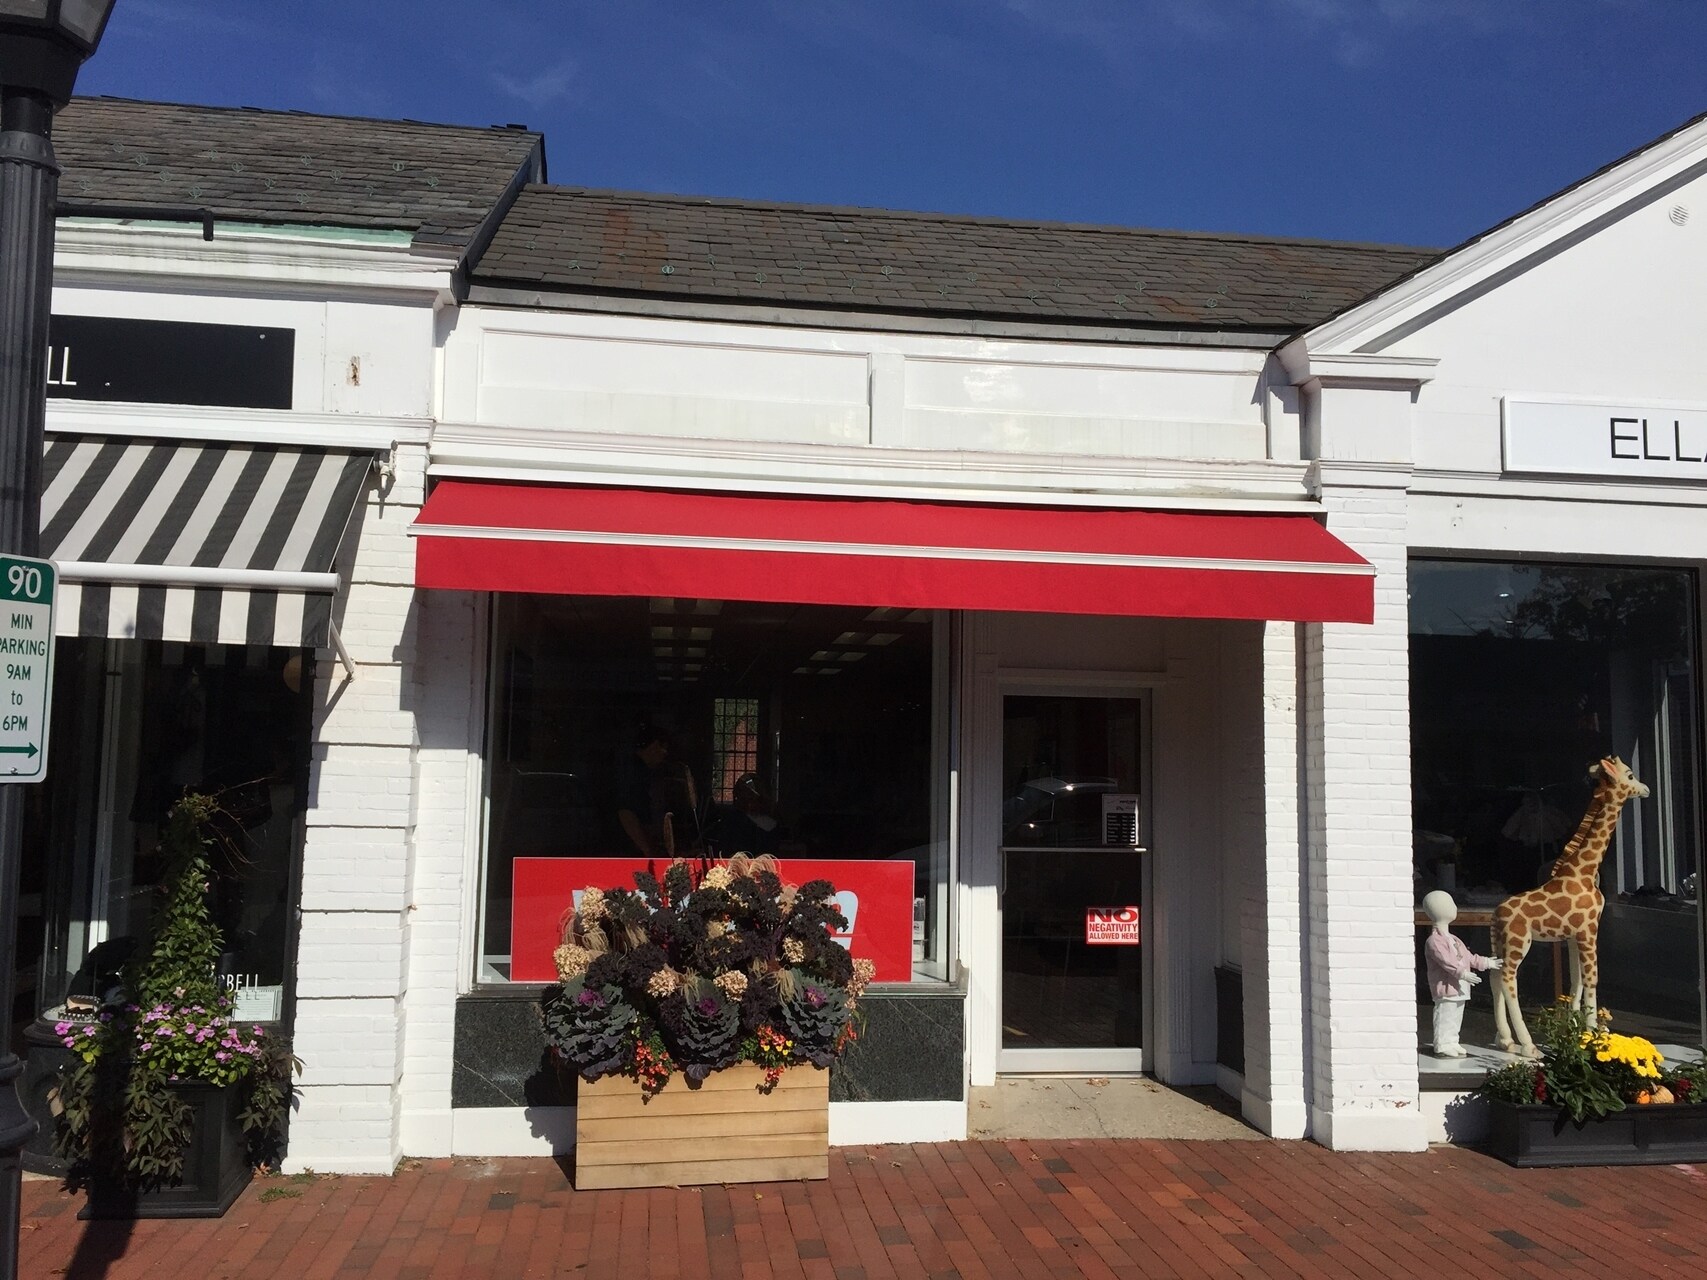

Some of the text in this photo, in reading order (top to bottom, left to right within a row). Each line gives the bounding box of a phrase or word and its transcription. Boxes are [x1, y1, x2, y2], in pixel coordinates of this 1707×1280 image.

[1609, 417, 1707, 463] ELL
[7, 565, 42, 599] 90
[10, 613, 33, 630] MIN
[6, 664, 31, 681] 9AM
[11, 690, 23, 705] to
[2, 715, 28, 731] 6PM
[1089, 909, 1138, 922] NO
[1089, 923, 1138, 932] NEGATIVITY
[1090, 932, 1138, 940] ALLOWED HERE
